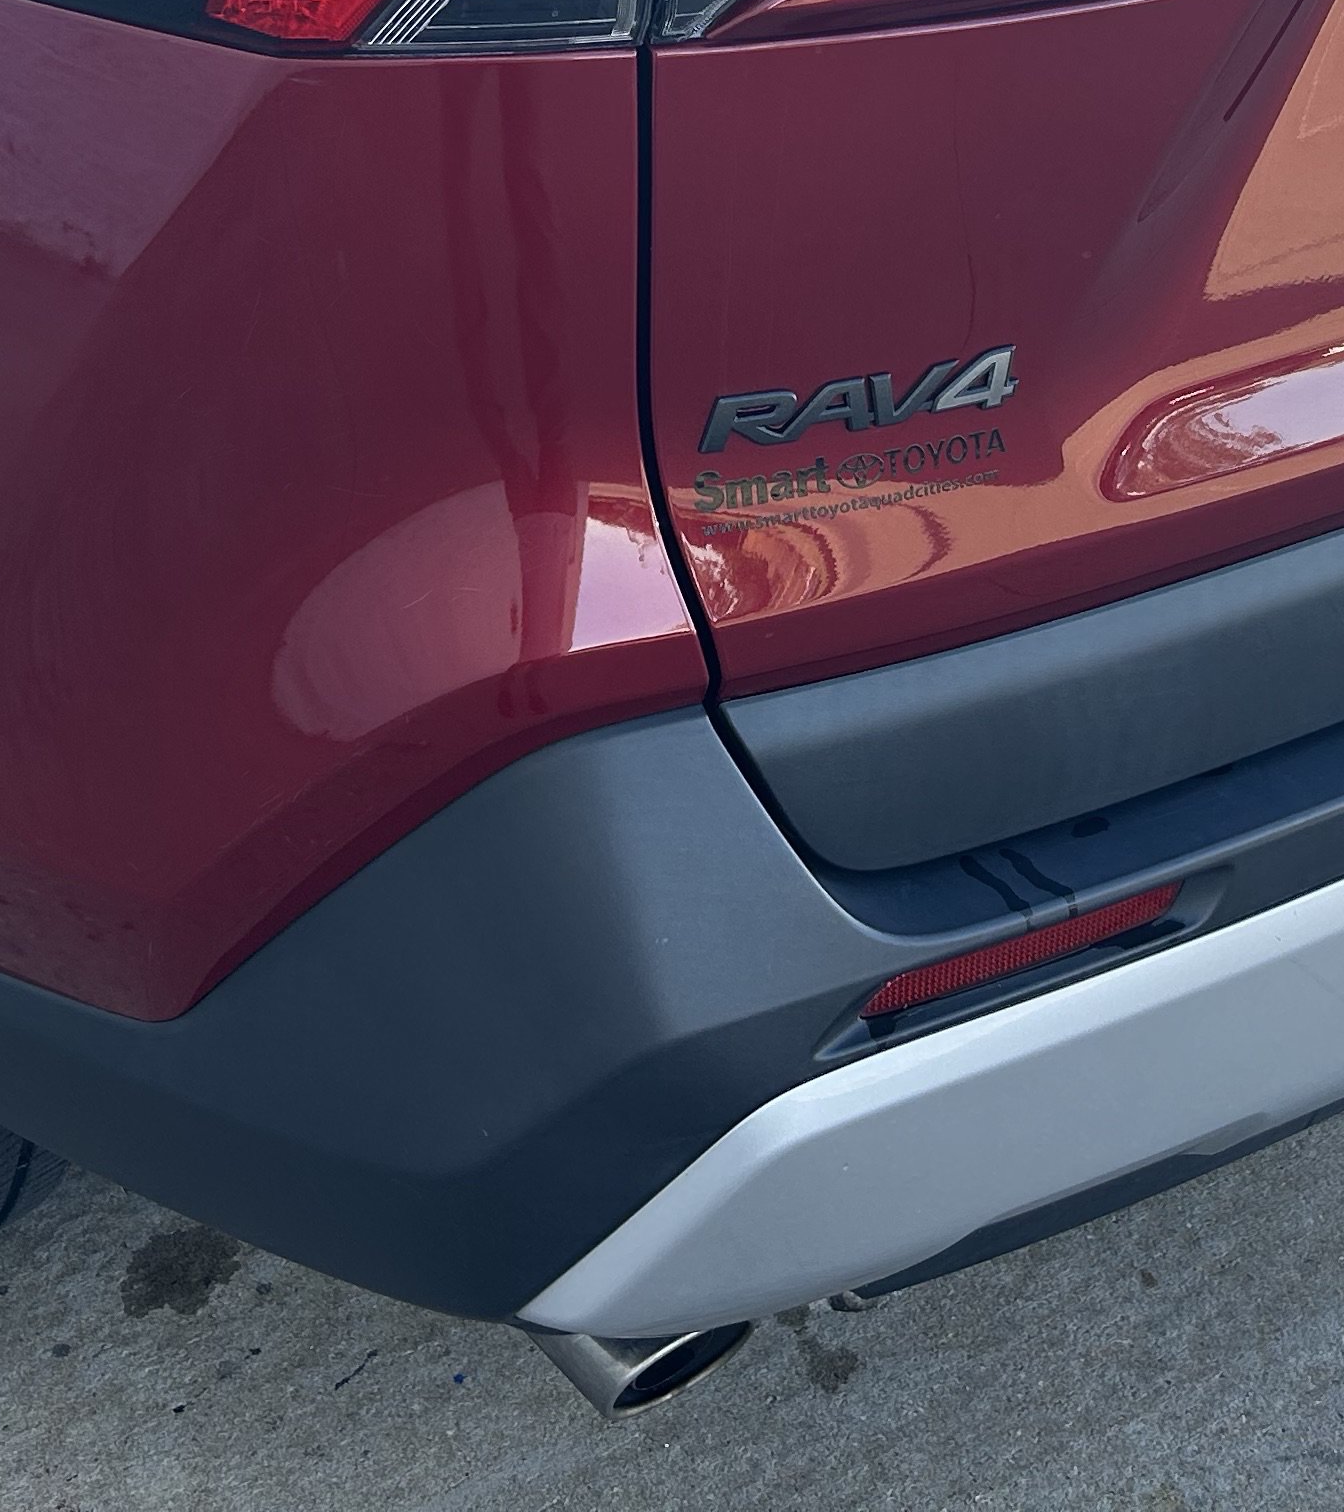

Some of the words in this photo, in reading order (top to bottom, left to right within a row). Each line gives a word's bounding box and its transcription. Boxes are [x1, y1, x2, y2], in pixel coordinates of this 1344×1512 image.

[697, 343, 1020, 455] RAV4
[692, 455, 832, 514] Smart
[884, 427, 1007, 478] TOYOTA
